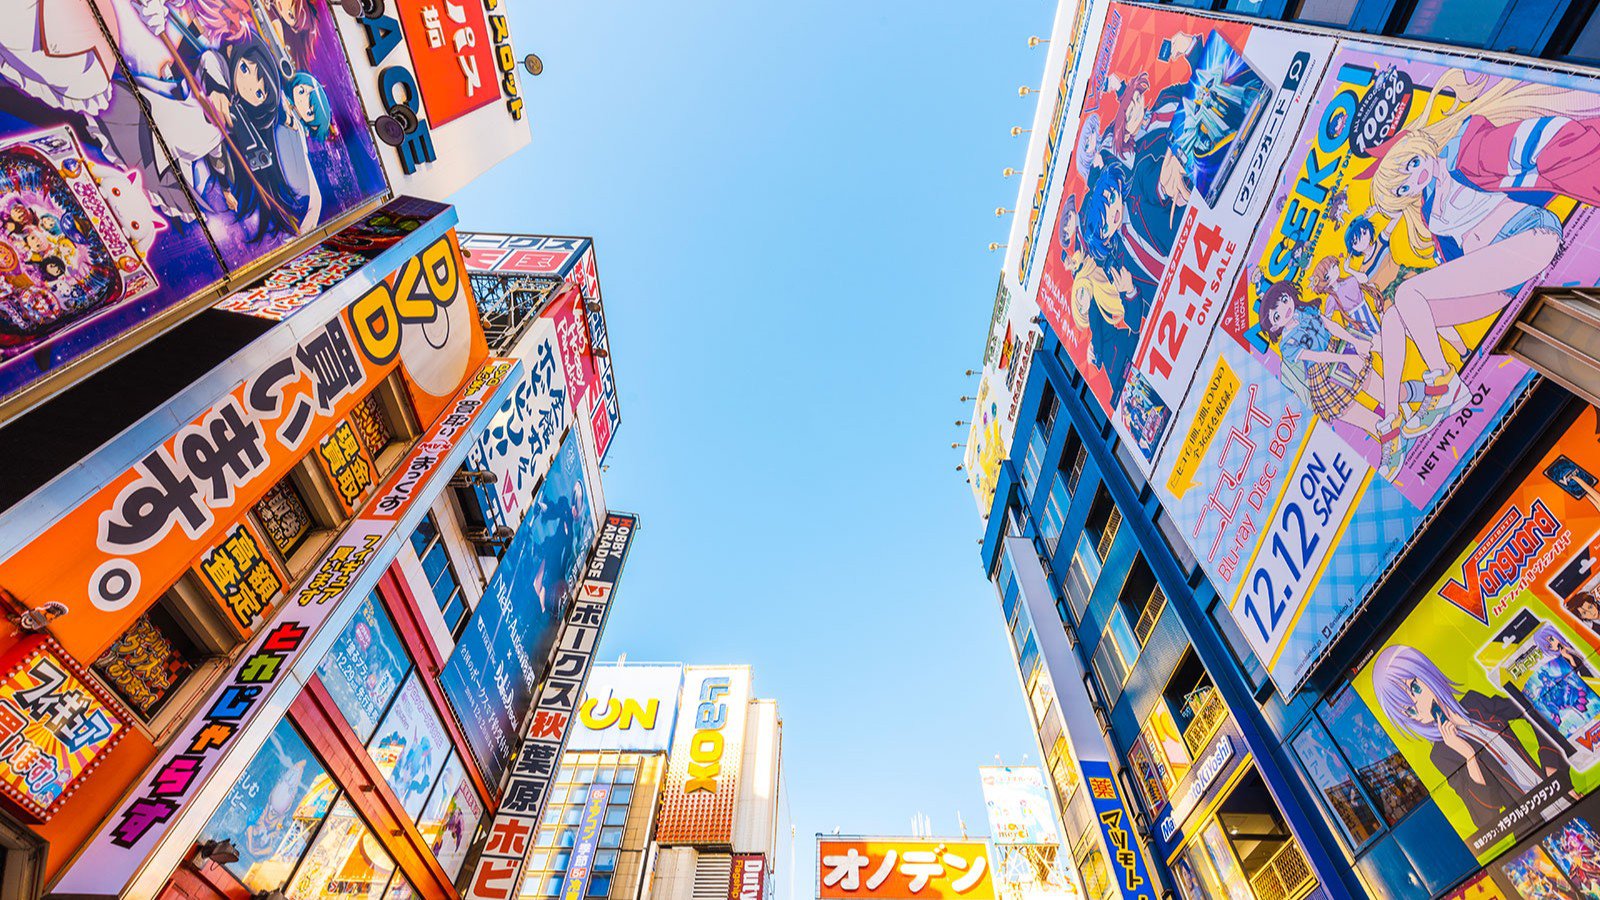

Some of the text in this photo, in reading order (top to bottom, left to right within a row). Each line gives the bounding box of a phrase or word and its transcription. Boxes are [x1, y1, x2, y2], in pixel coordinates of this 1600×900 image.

[1239, 97, 1287, 202] ヴァンガード
[1357, 76, 1405, 154] 100%
[1148, 221, 1225, 380] 12.14
[1197, 241, 1236, 326] ON SALE
[336, 420, 372, 495] 現金
[1416, 382, 1492, 482] NET WT. 20 OZ
[320, 439, 361, 506] 買取
[1193, 384, 1273, 563] ニセコイ
[1217, 404, 1302, 583] Blu-ray Disc BOX
[1299, 451, 1328, 501] ON
[1313, 452, 1354, 528] SALE
[224, 526, 283, 605] 高額
[298, 545, 356, 607] 買います
[323, 534, 382, 603] フィギュア
[587, 517, 618, 578] PARADISE
[612, 519, 633, 559] HOBBY
[1243, 501, 1321, 644] 12.12
[1439, 498, 1560, 625] Vanguard
[202, 550, 264, 628] 査定
[13, 657, 113, 753] フィギュア
[334, 650, 356, 682] 12.29
[1089, 777, 1117, 799] 薬
[1161, 737, 1230, 839] MatoKiYoshi
[1497, 780, 1562, 832] オラクルシンクタンク
[732, 859, 744, 899] Flagship
[822, 844, 987, 893] オノデン
[1100, 810, 1149, 900] マツモト
